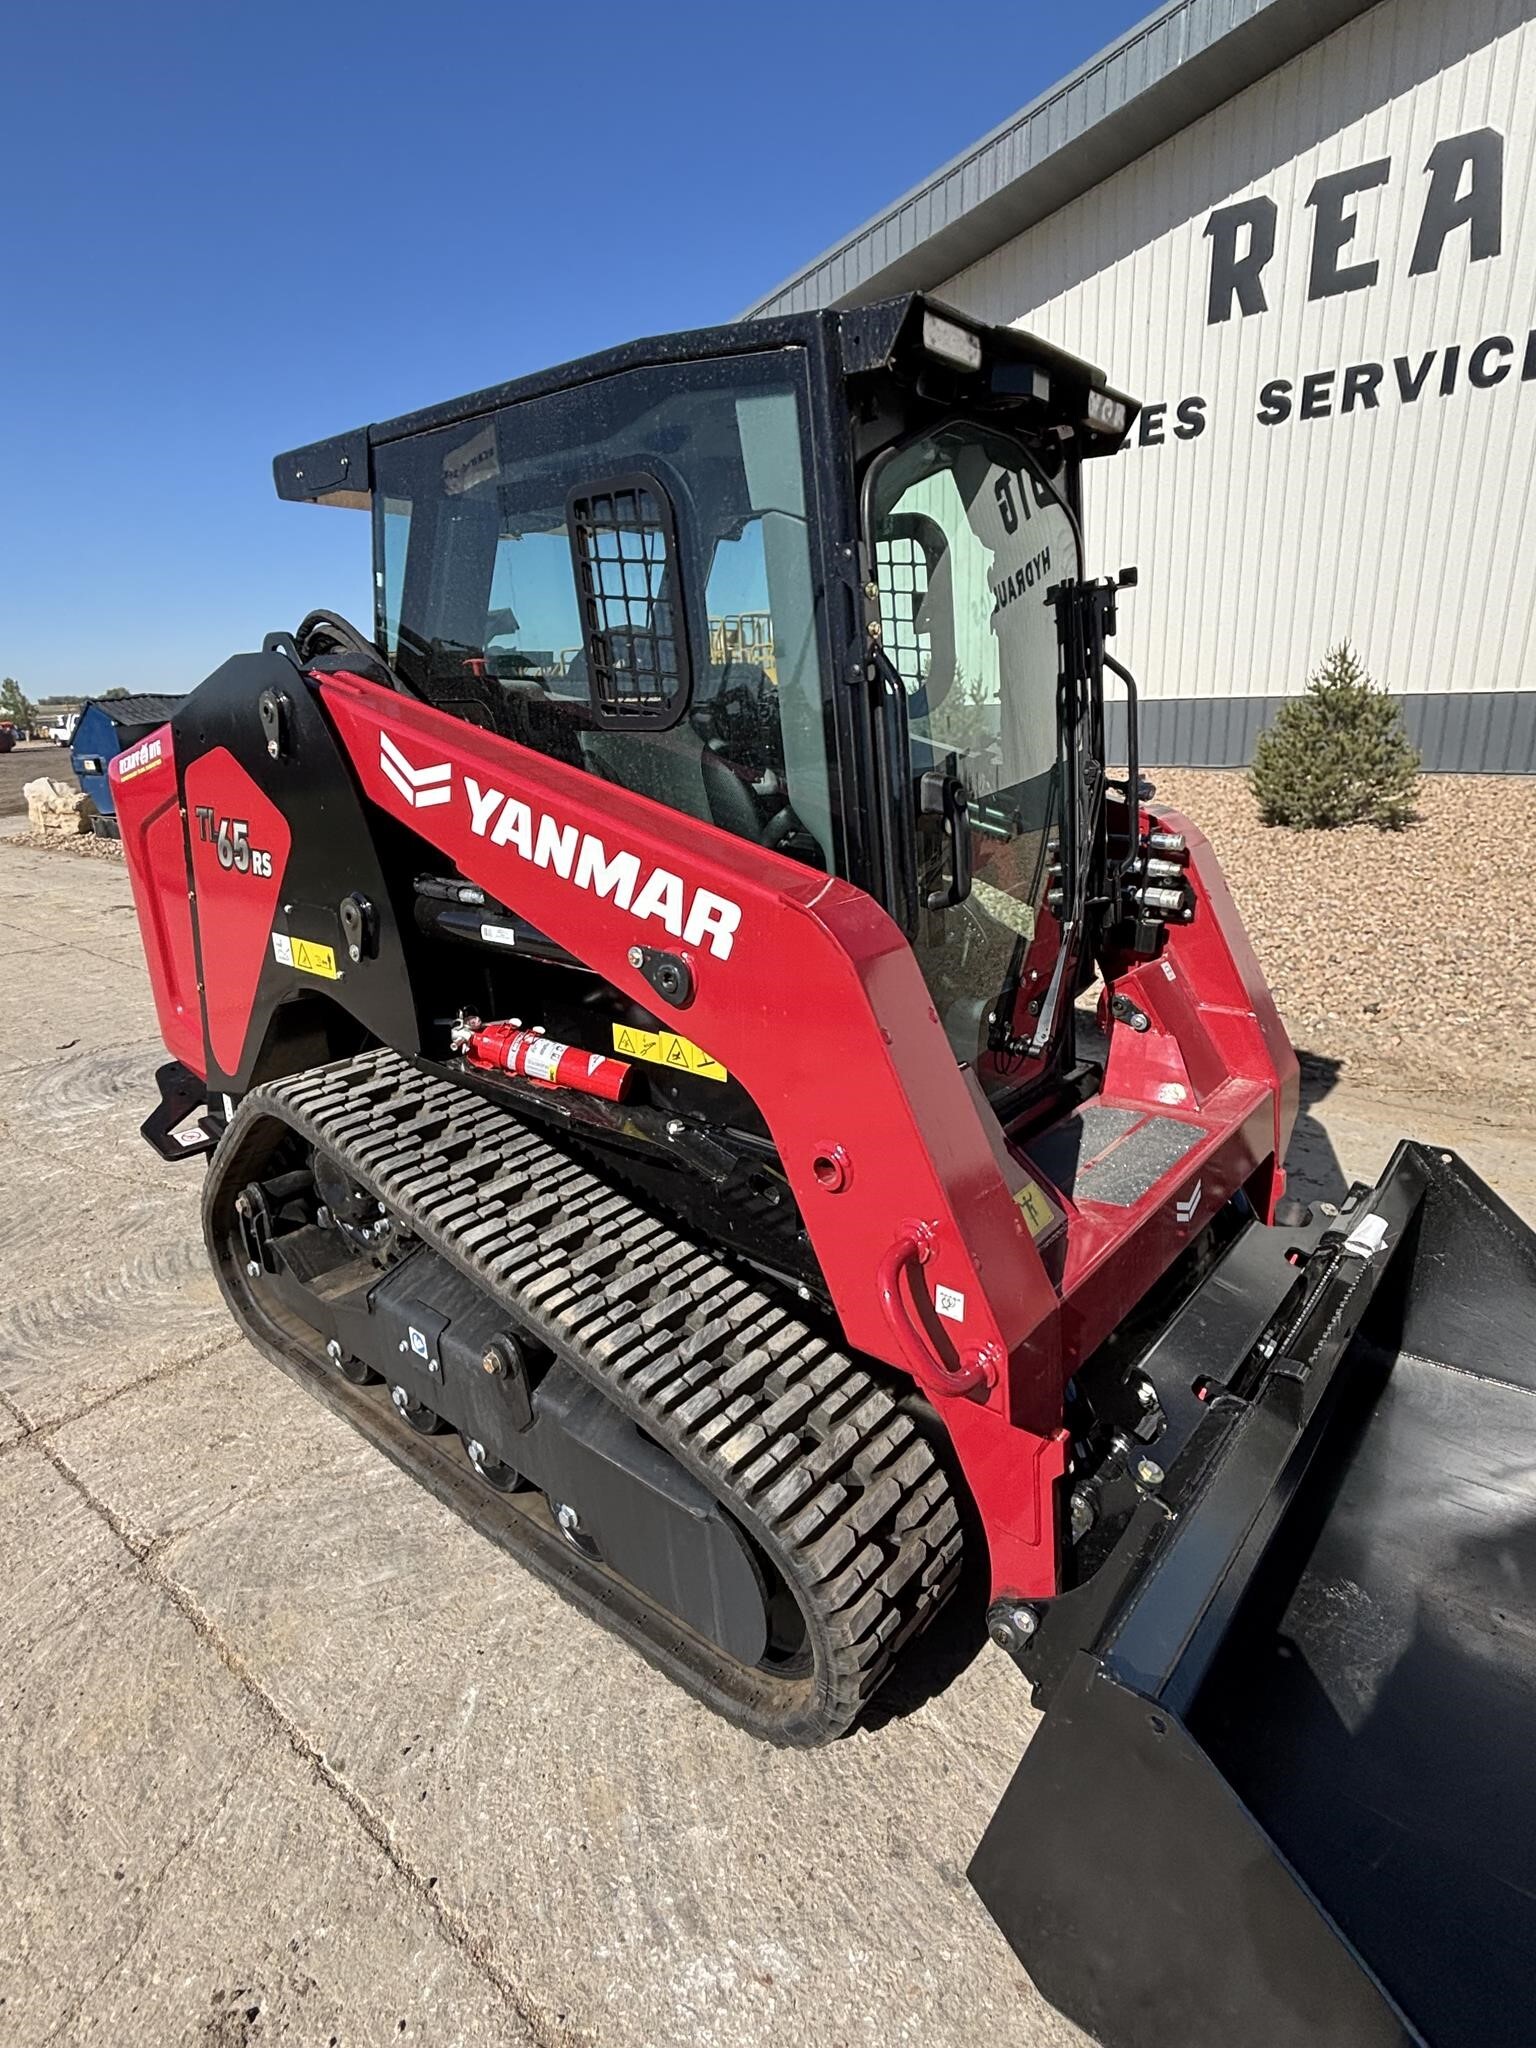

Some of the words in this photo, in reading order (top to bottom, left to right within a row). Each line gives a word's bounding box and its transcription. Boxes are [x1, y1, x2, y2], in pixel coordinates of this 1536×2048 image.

[1203, 126, 1505, 326] REA
[1119, 396, 1208, 450] ES
[463, 775, 743, 962] YANMAR
